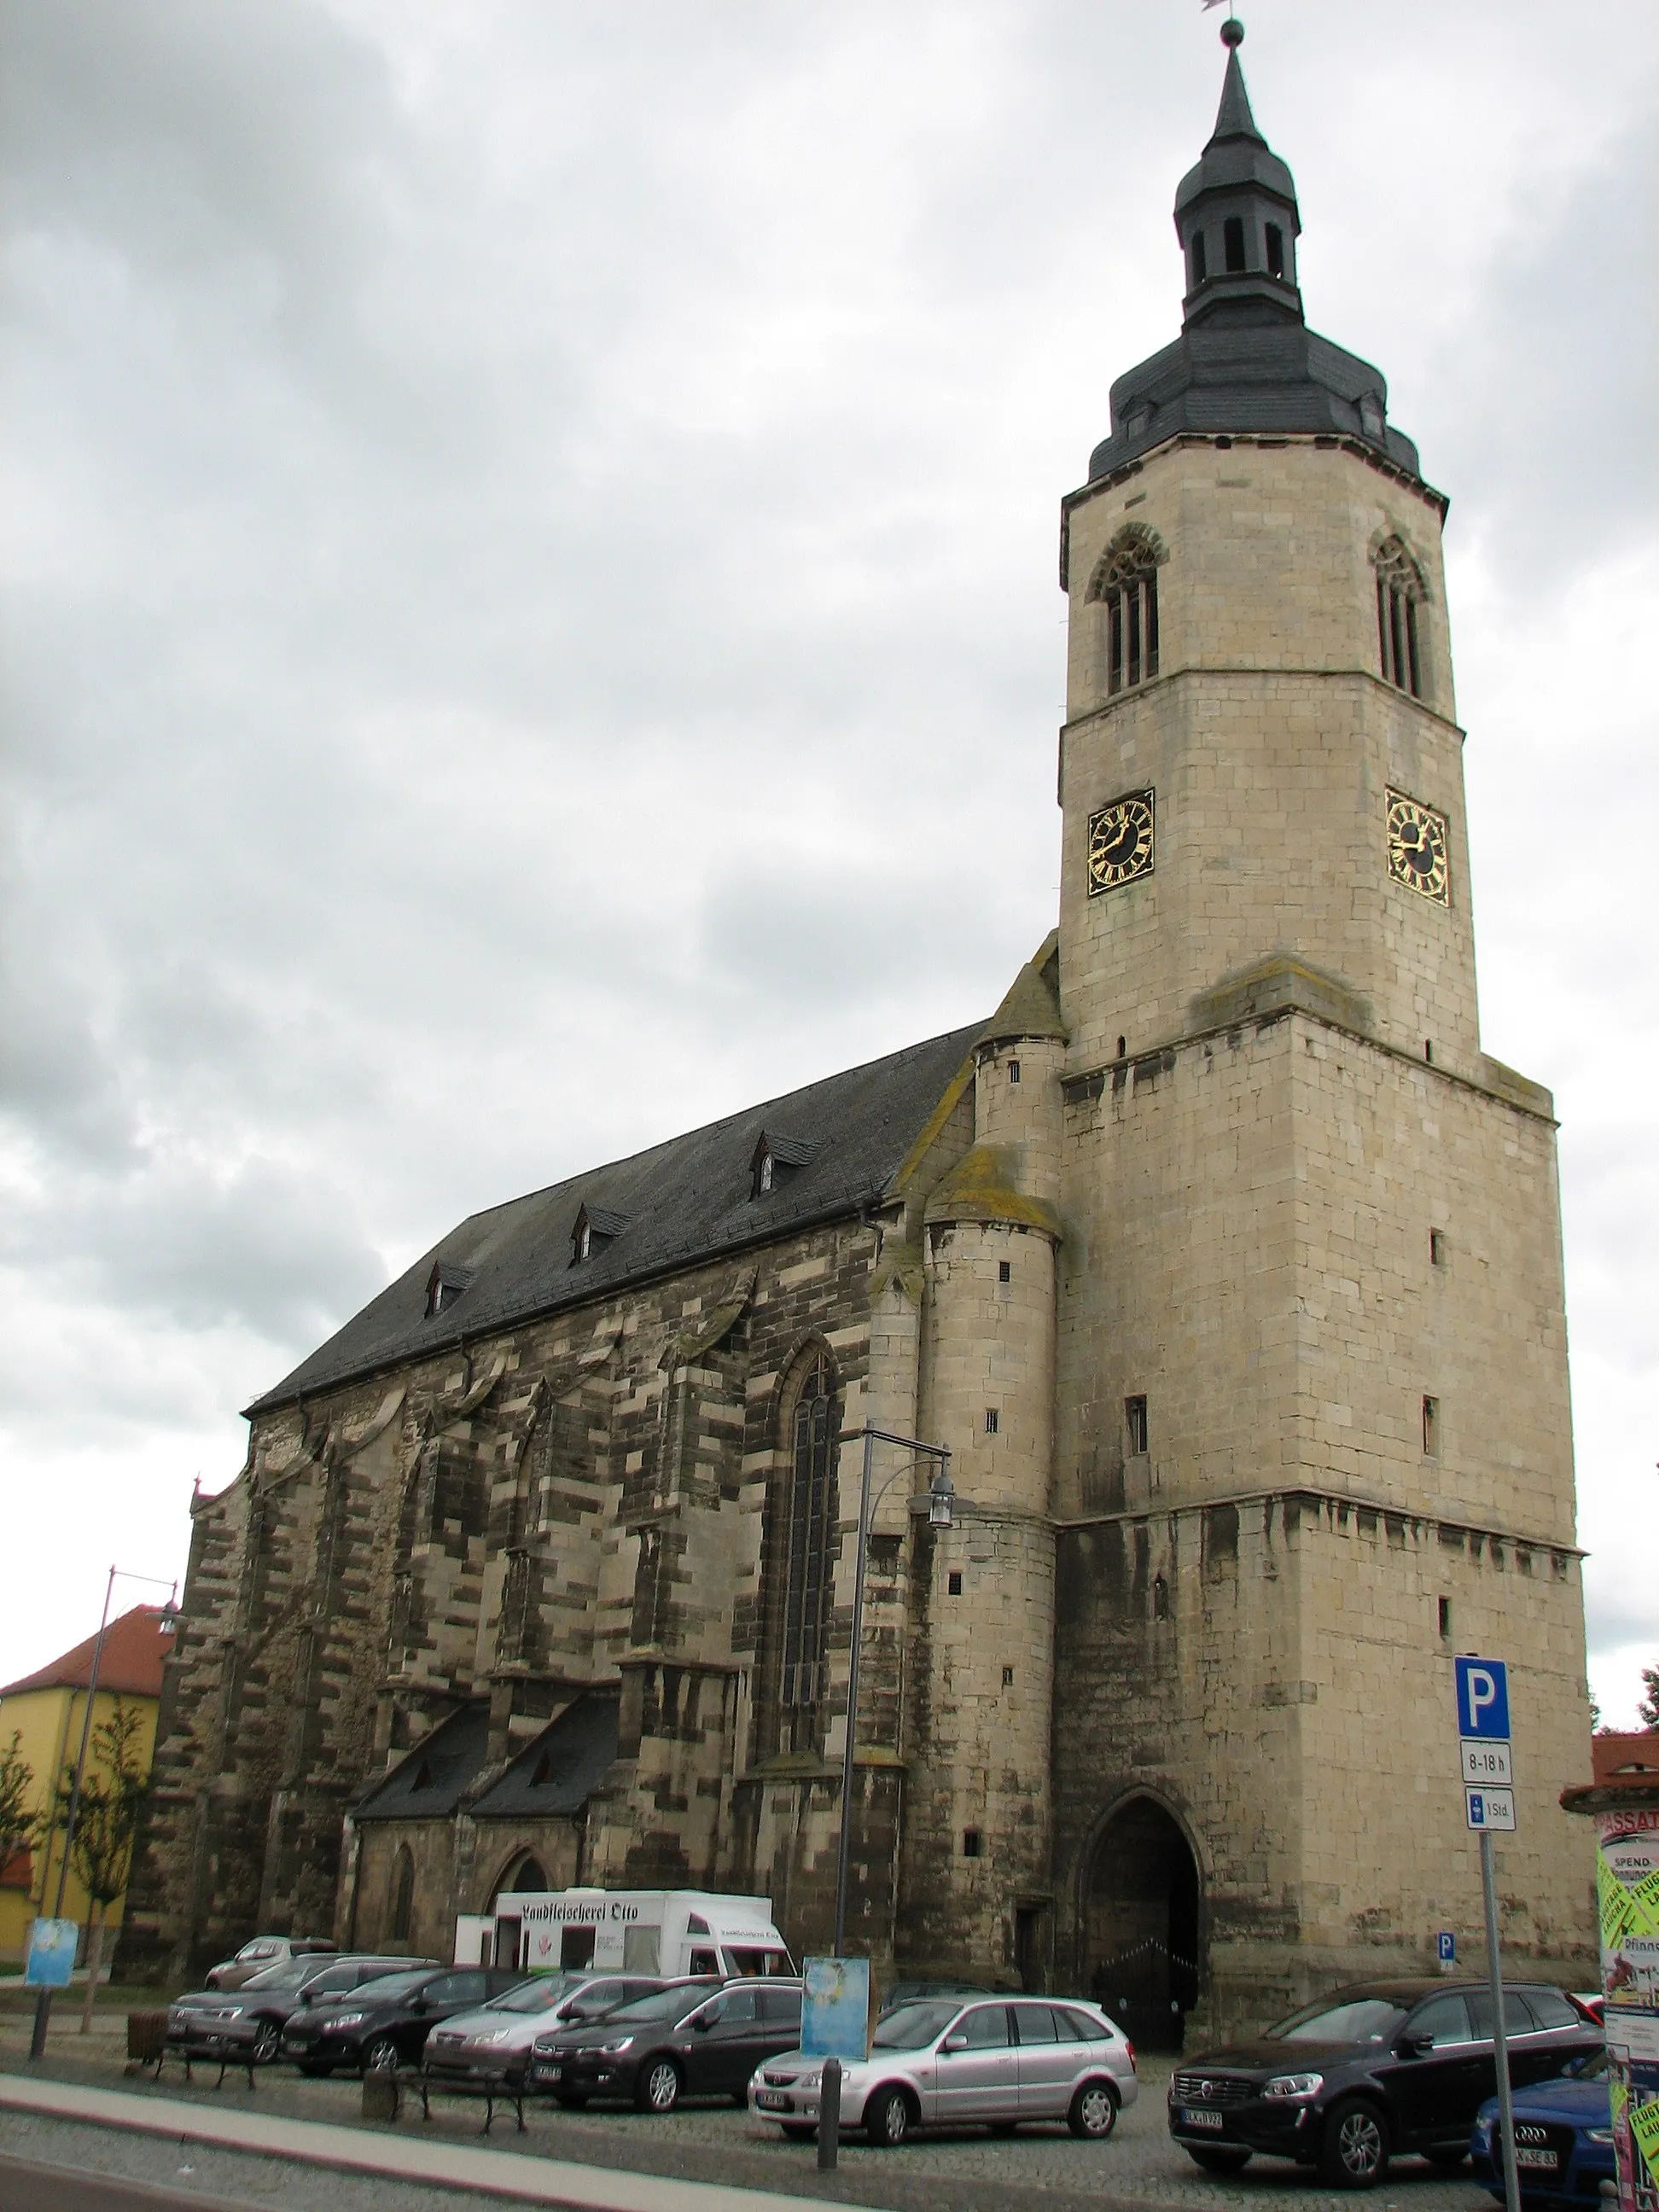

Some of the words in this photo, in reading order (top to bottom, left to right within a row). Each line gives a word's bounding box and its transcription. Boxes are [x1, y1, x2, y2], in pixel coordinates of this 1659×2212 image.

[1467, 1668, 1495, 1728] P
[1470, 1754, 1495, 1772] 8-18
[1498, 1755, 1505, 1773] h
[1493, 1802, 1510, 1817] Std.
[1633, 1870, 1659, 1899] FLUG
[611, 1902, 638, 1920] Otto
[1441, 1935, 1452, 1958] P
